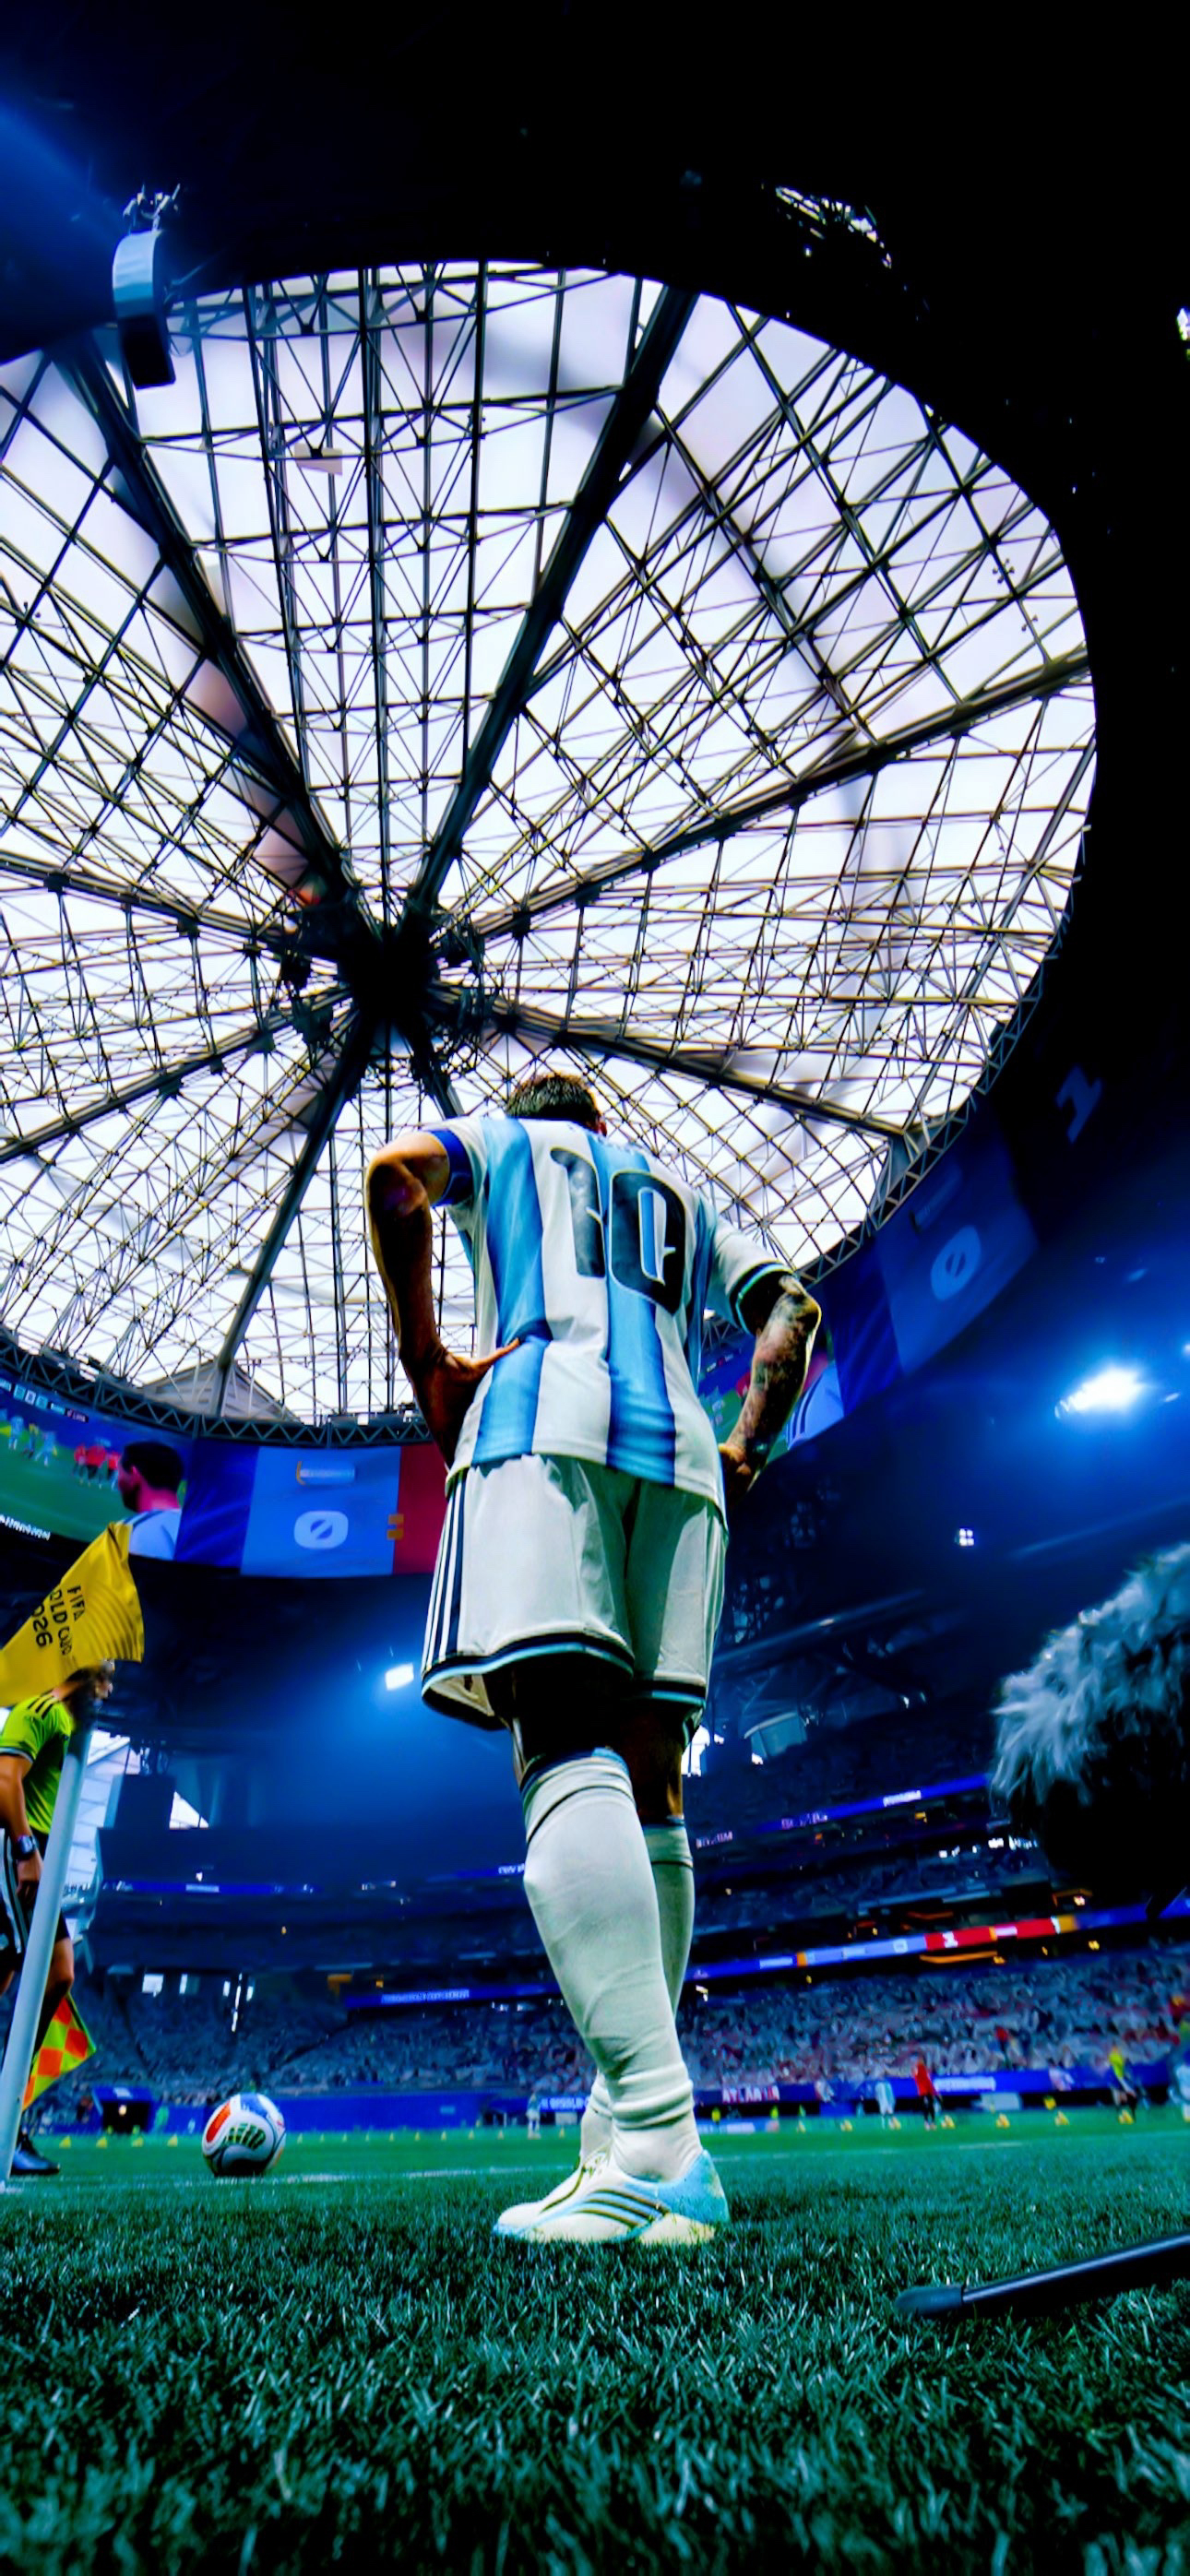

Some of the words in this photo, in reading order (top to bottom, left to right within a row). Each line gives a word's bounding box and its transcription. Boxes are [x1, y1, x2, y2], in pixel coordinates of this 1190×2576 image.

[549, 1146, 686, 1315] 10
[50, 1588, 67, 1623] RLD
[66, 1585, 85, 1621] FIFA
[32, 1602, 54, 1647] 026
